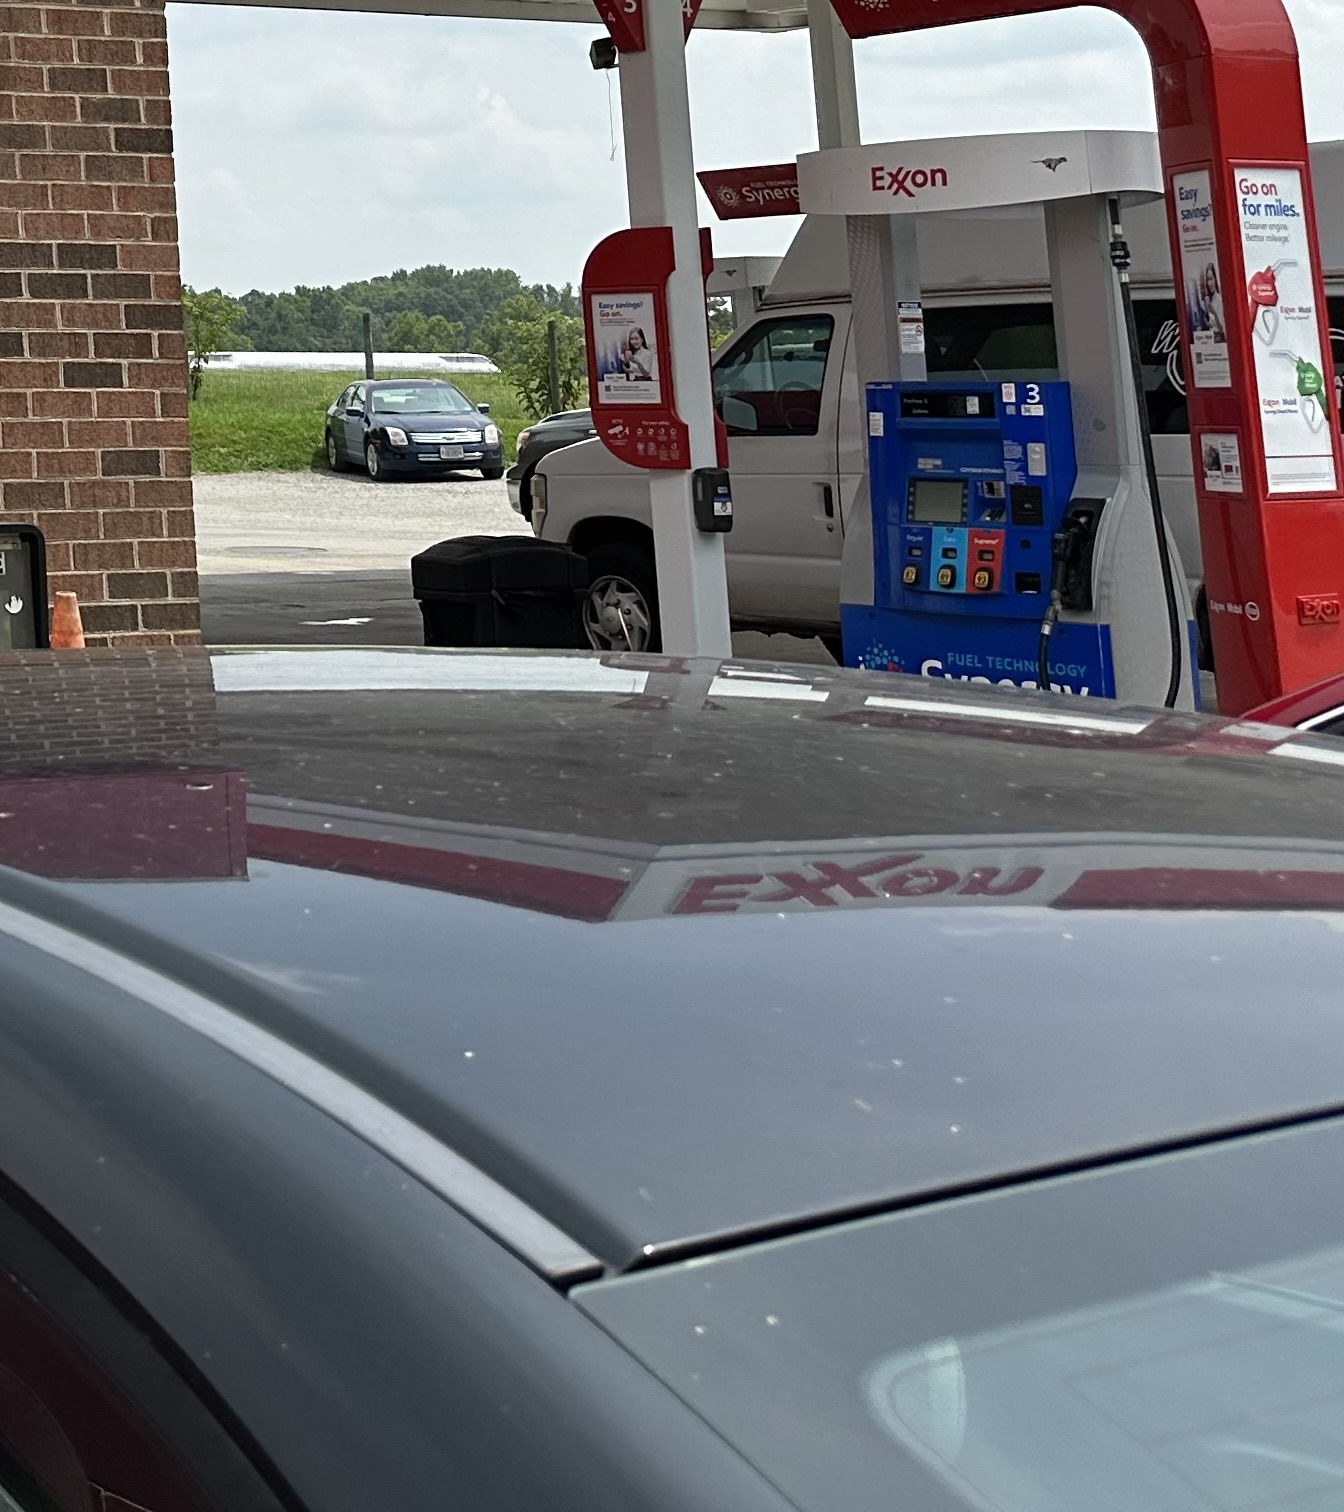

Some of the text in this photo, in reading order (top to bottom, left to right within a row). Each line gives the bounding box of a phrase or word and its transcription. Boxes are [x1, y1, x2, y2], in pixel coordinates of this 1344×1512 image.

[607, 11, 616, 23] 4
[871, 166, 948, 198] Exxon
[1238, 178, 1278, 196] Go on
[741, 185, 800, 206] Synerg
[1178, 187, 1199, 203] Easy
[1242, 197, 1262, 216] for
[598, 302, 615, 311] Easy
[1025, 383, 1041, 404] 3
[947, 652, 983, 668] FUEL
[985, 654, 1088, 679] TECHNLOGY
